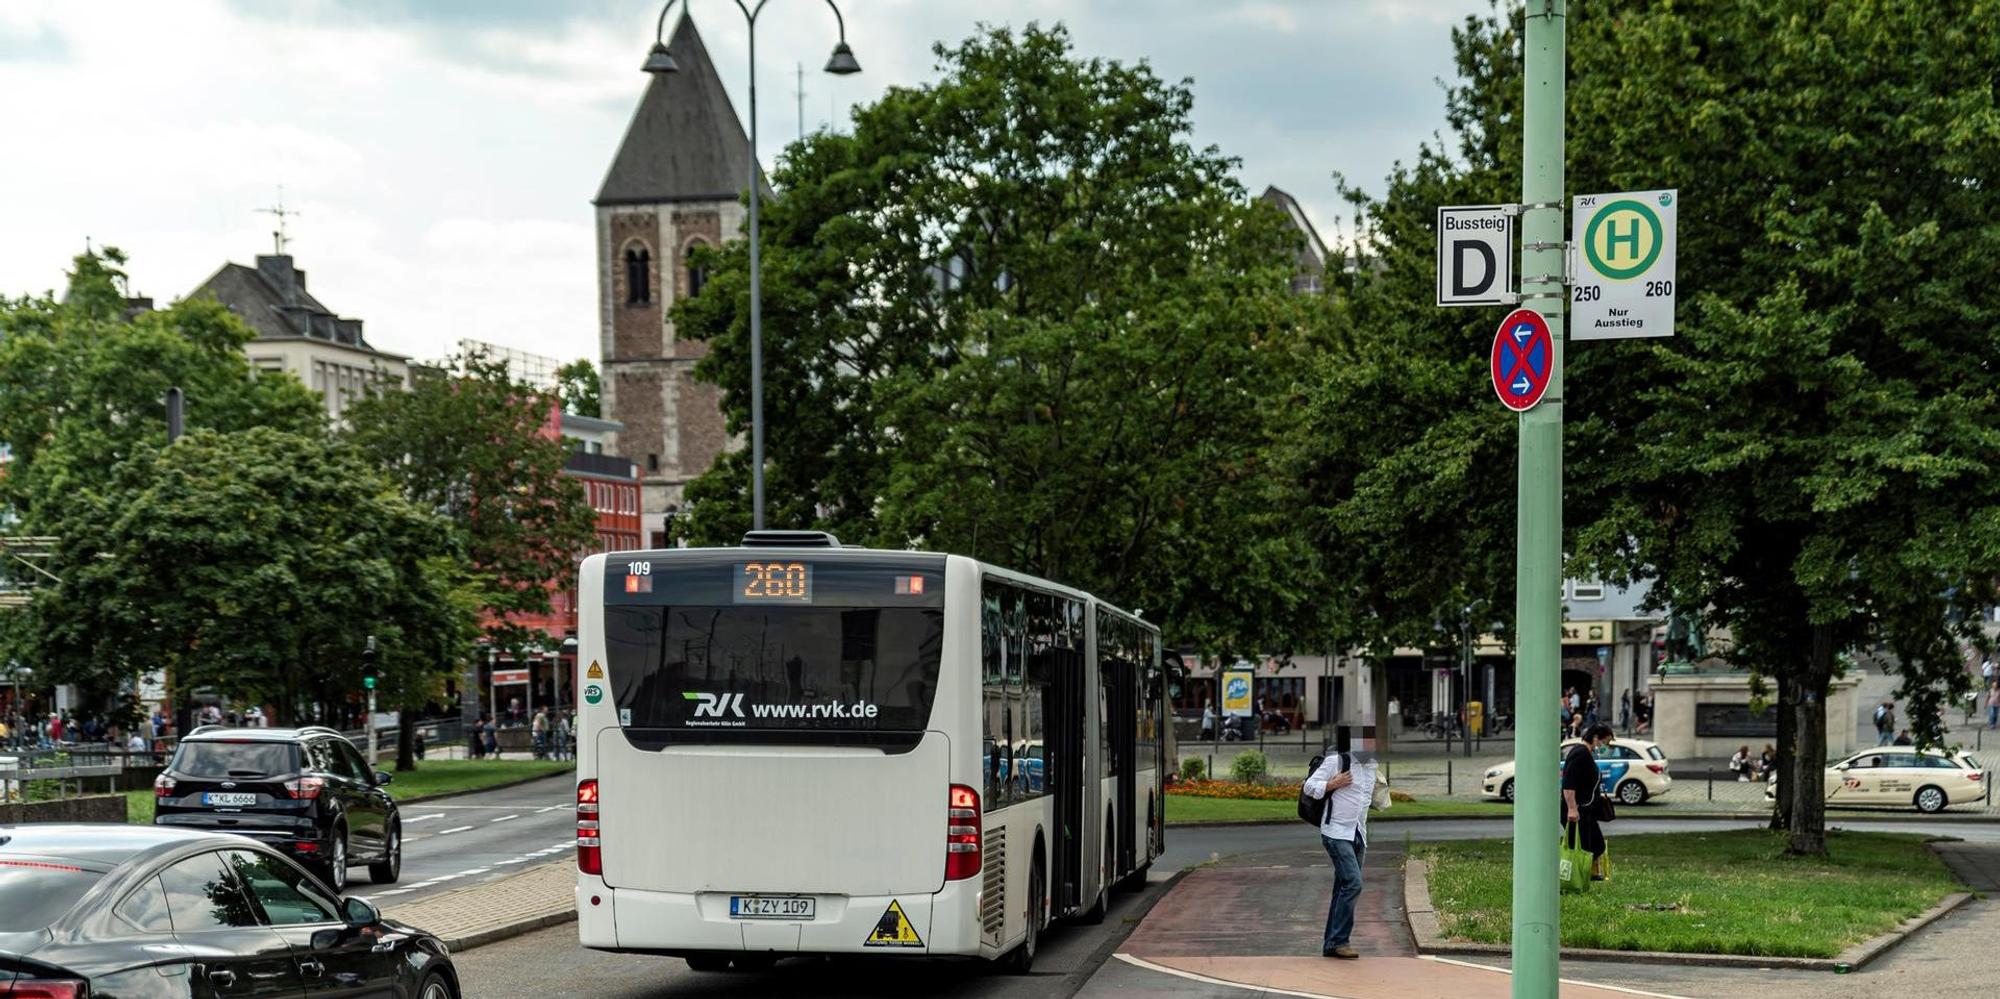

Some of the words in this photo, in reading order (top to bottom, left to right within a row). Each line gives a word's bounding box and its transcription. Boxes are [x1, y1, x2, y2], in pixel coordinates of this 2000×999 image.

[1445, 215, 1505, 233] Bussteig
[1606, 218, 1640, 261] H
[1452, 239, 1496, 296] D
[1574, 285, 1601, 302] 250
[1645, 280, 1672, 297] 260
[1608, 308, 1629, 317] Nur
[1594, 319, 1643, 328] Ausstieg
[627, 561, 650, 575] 109
[744, 561, 806, 597] 260
[752, 700, 878, 718] www.rvk.de
[743, 900, 751, 913] K
[762, 900, 781, 913] ZY
[783, 900, 808, 913] 109
